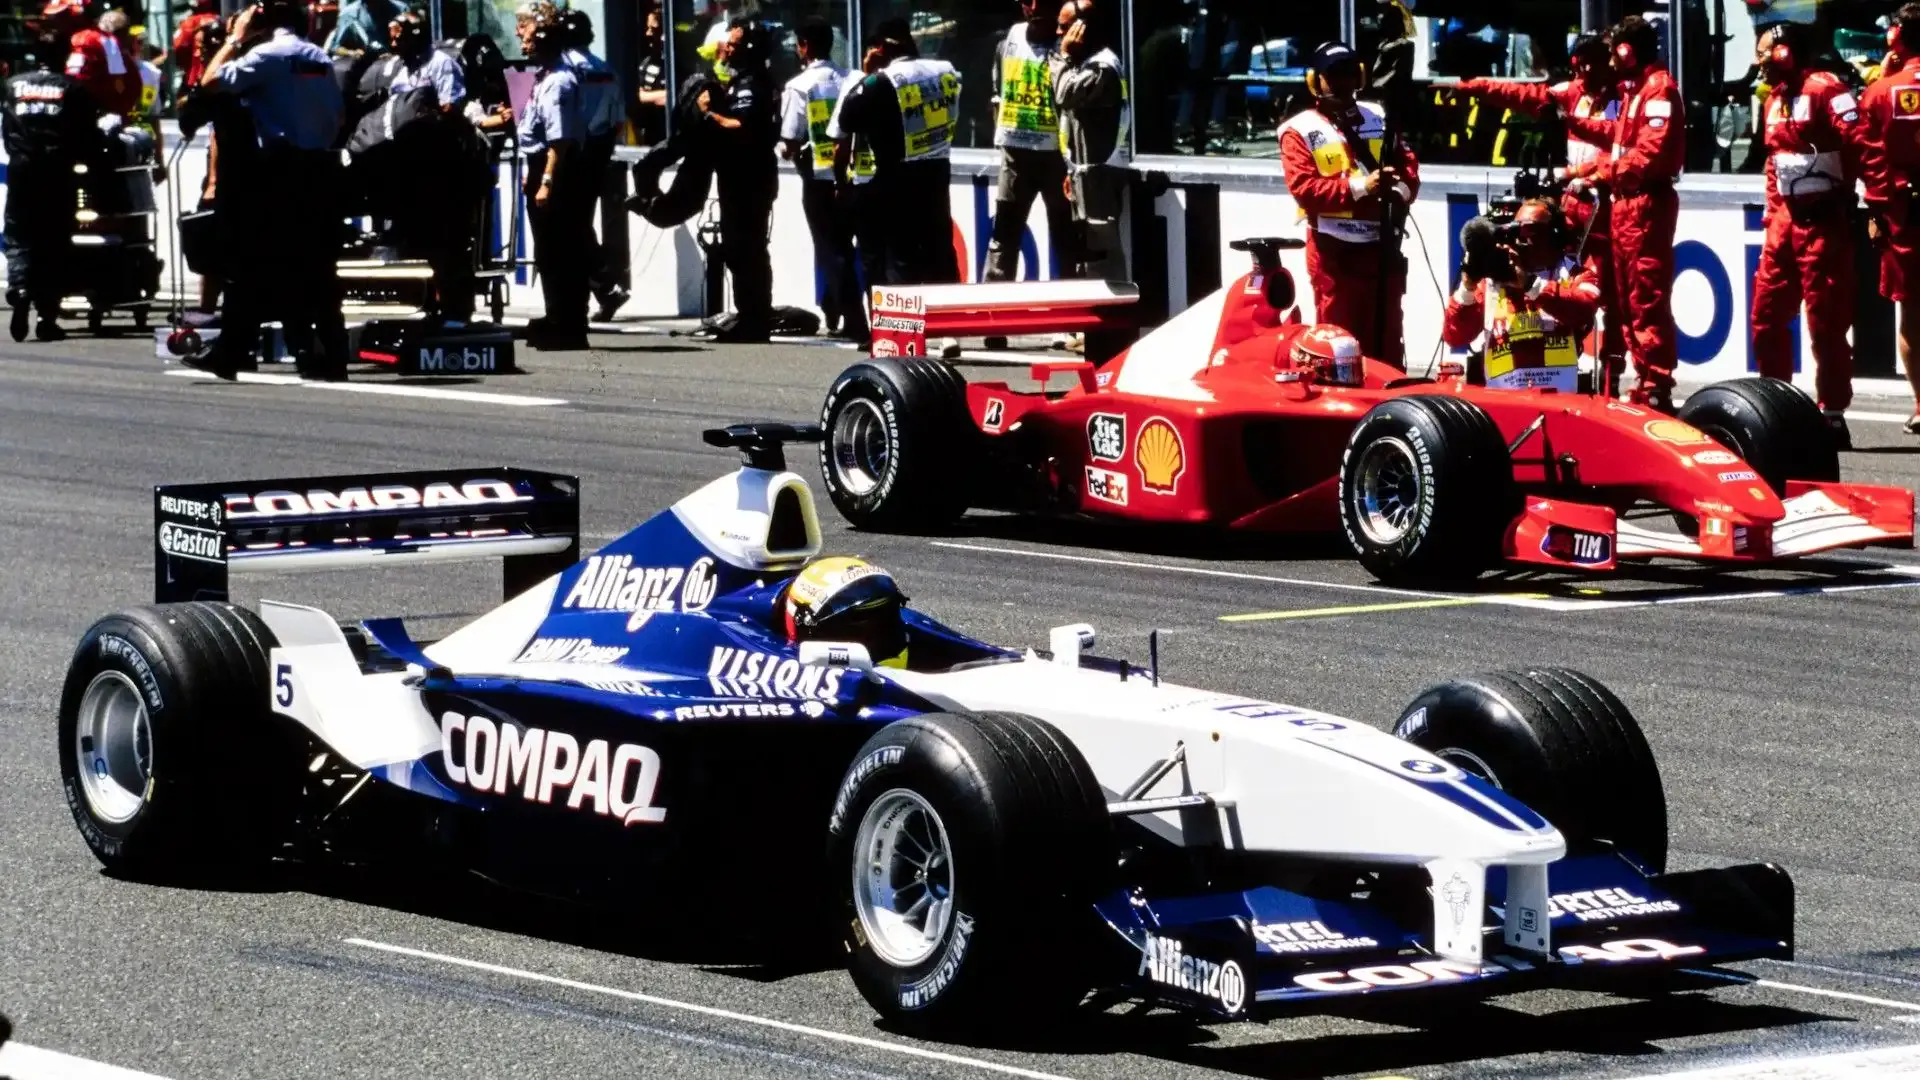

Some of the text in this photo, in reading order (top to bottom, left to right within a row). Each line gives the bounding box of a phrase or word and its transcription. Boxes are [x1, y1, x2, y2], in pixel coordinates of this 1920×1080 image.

[886, 293, 922, 311] Shell
[420, 347, 495, 370] Mobil
[906, 342, 915, 356] 1
[1094, 415, 1120, 440] tic
[1091, 432, 1121, 457] tac
[1086, 469, 1126, 503] FedEx
[1405, 425, 1436, 538] BRIDGESTONE
[160, 495, 209, 520] REUTERS
[226, 478, 535, 518] COMPAQ
[172, 527, 221, 558] Castrol
[1573, 533, 1602, 559] TIM
[563, 555, 684, 613] Allianz
[108, 638, 162, 709] MICHELIN
[276, 664, 294, 708] 5
[708, 646, 845, 699] VISIONS
[674, 703, 795, 721] REUTERS
[441, 711, 667, 827] COMPAQ
[837, 747, 903, 818] MICHELIN
[1576, 900, 1681, 922] NETWORKS
[1267, 937, 1379, 954] NETWORKS
[902, 933, 968, 1008] MICHELIN
[1138, 934, 1220, 998] Allianz
